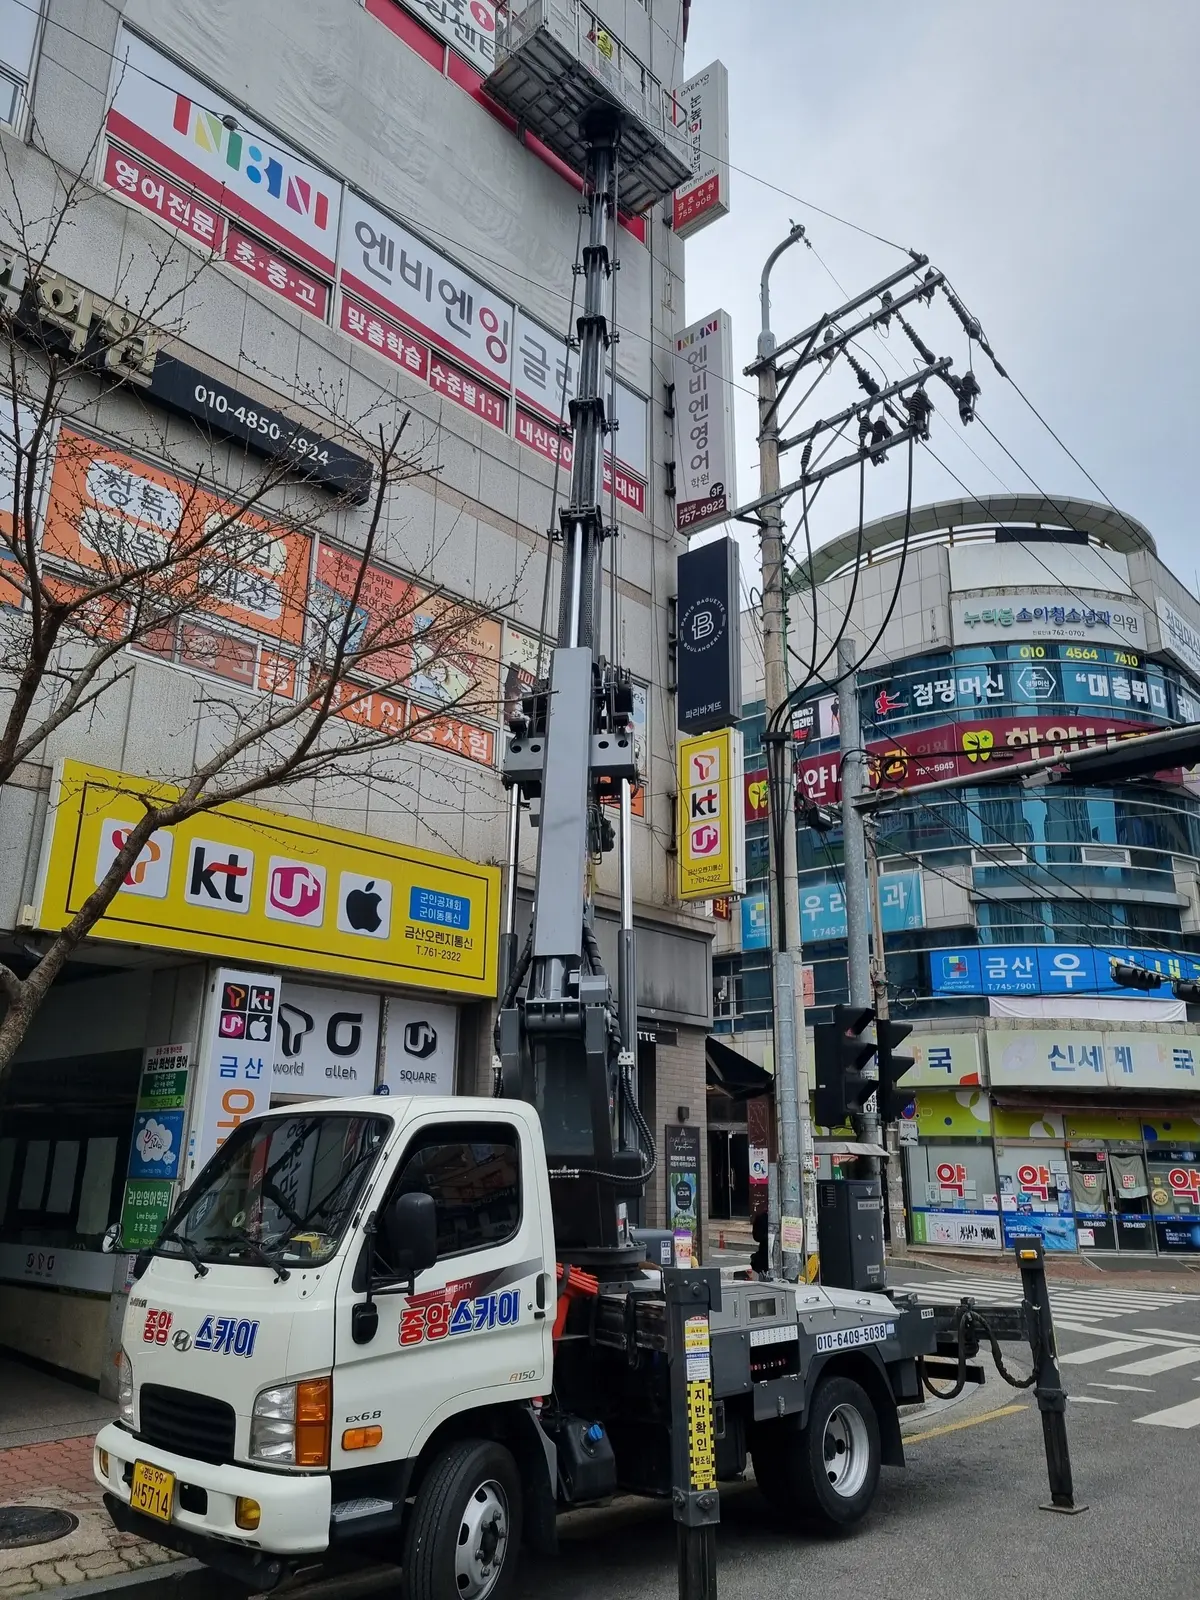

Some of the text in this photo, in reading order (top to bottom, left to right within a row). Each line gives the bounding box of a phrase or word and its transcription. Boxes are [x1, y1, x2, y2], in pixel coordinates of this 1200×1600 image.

[114, 159, 216, 241] 영어전문
[346, 305, 423, 367] 맞춤학습
[687, 344, 710, 471] 엔비엔영어
[690, 472, 711, 490] 학원
[711, 485, 724, 498] 3F
[679, 498, 725, 527] 757-9922
[695, 597, 726, 613] BAGUETTE
[1052, 628, 1086, 638] 762-0702
[1019, 646, 1139, 668] 010 4564 7410
[912, 672, 1005, 707] 점핑머신
[685, 700, 723, 719] 파리바게뜨
[691, 788, 718, 818] kt
[190, 845, 248, 904] kt
[420, 892, 462, 911] 군인공제회
[419, 906, 461, 925] 군이동통신
[404, 925, 473, 951] 금산오렌지통신
[415, 944, 462, 962] T.761-2322
[985, 957, 1035, 979] 금산
[987, 982, 1036, 992] T.745-7901
[251, 987, 273, 1012] kt
[219, 1055, 264, 1080] 금산
[272, 1061, 305, 1077] world
[324, 1065, 358, 1081] olleh
[400, 1069, 438, 1085] SQUARE
[936, 1162, 967, 1199] 약
[1016, 1163, 1050, 1202] 약
[127, 1187, 169, 1208] 라임영어학원
[444, 1280, 474, 1295] MIGHTY
[143, 1307, 261, 1359] 중앙 스카이
[817, 1325, 886, 1351] 010-6409-5038
[508, 1369, 536, 1382] A150
[345, 1410, 382, 1424] EX6.8
[694, 1388, 708, 1452] 지반확인
